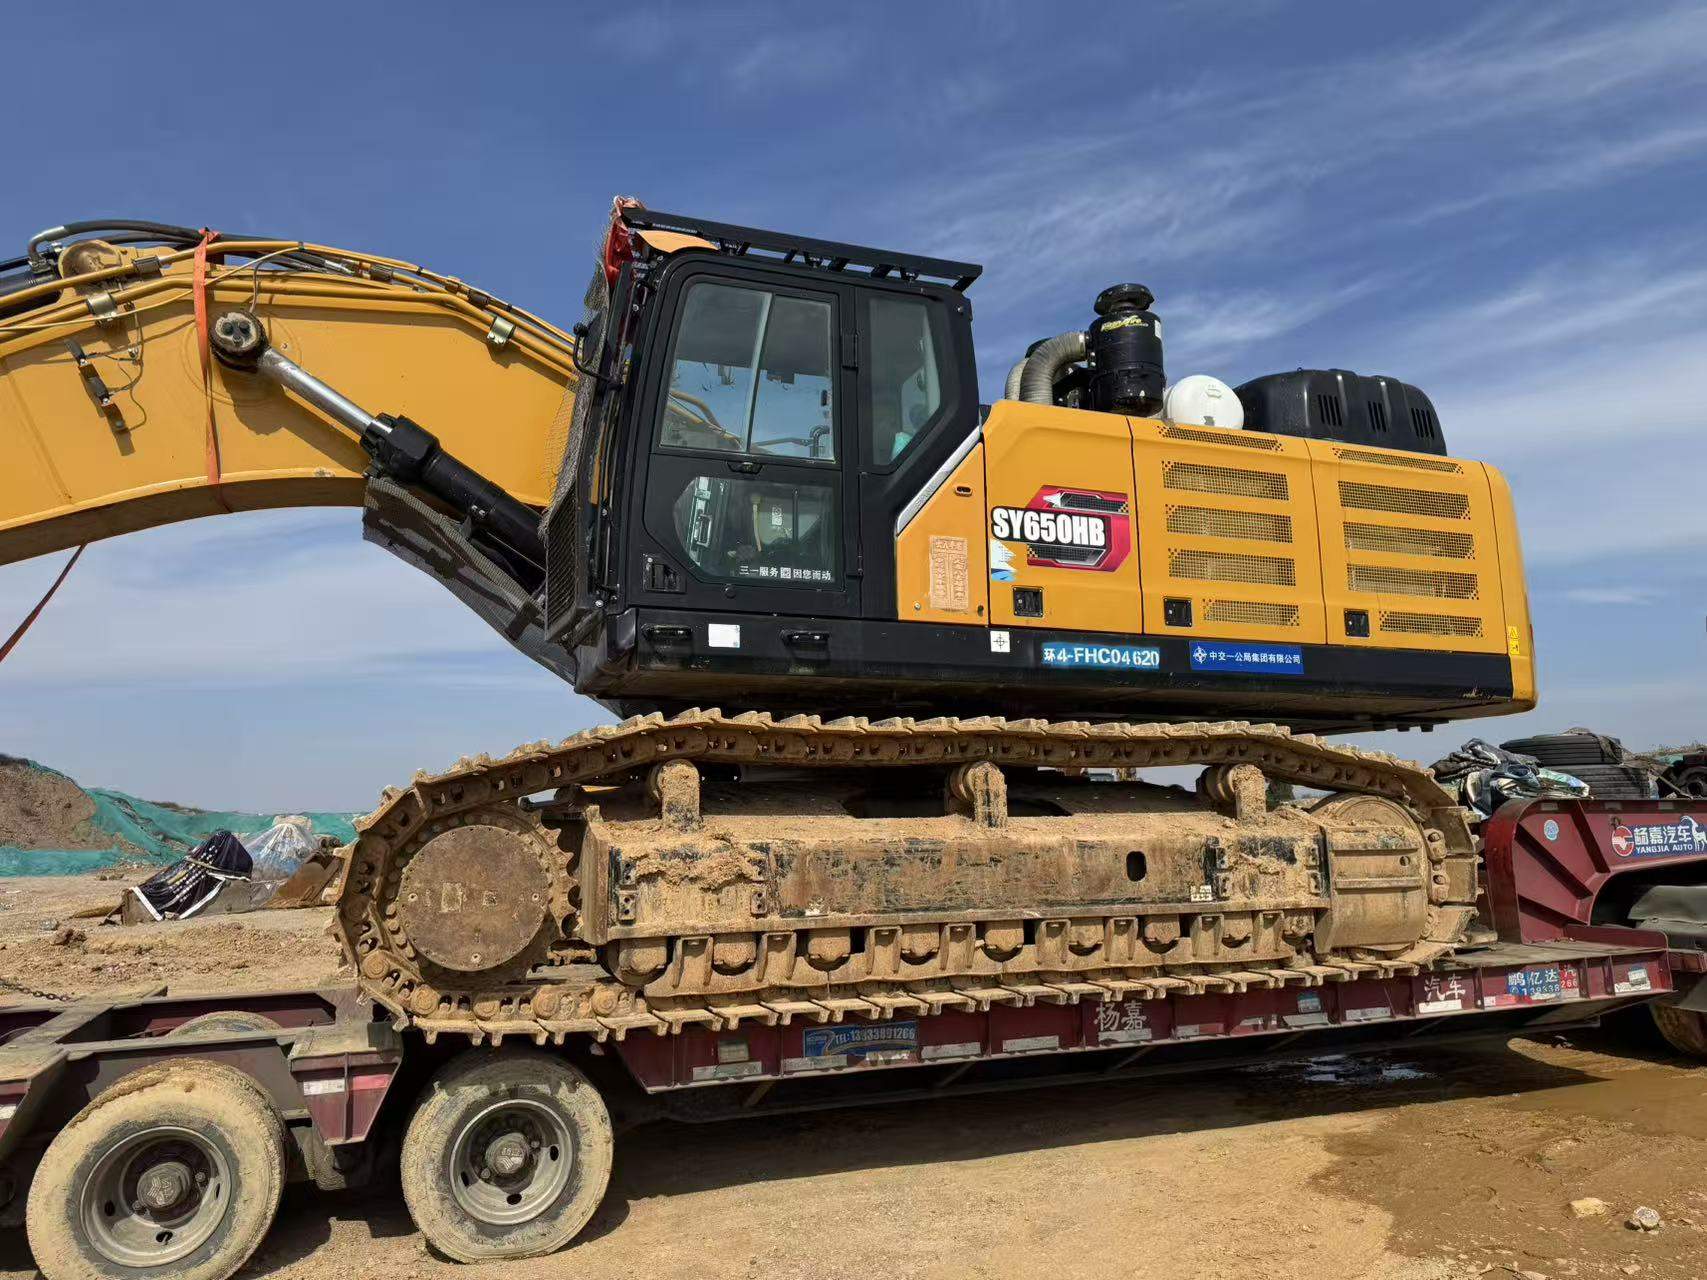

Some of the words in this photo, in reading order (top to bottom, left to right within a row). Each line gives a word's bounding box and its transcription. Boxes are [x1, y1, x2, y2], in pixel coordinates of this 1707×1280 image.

[992, 507, 1105, 547] SY650HB
[1209, 651, 1301, 664] 中交一公局集团有限公司
[1635, 845, 1670, 854] YANGJIA
[1672, 844, 1693, 852] AUTO
[1424, 973, 1466, 1001] 汽车
[1093, 997, 1147, 1031] 杨嘉
